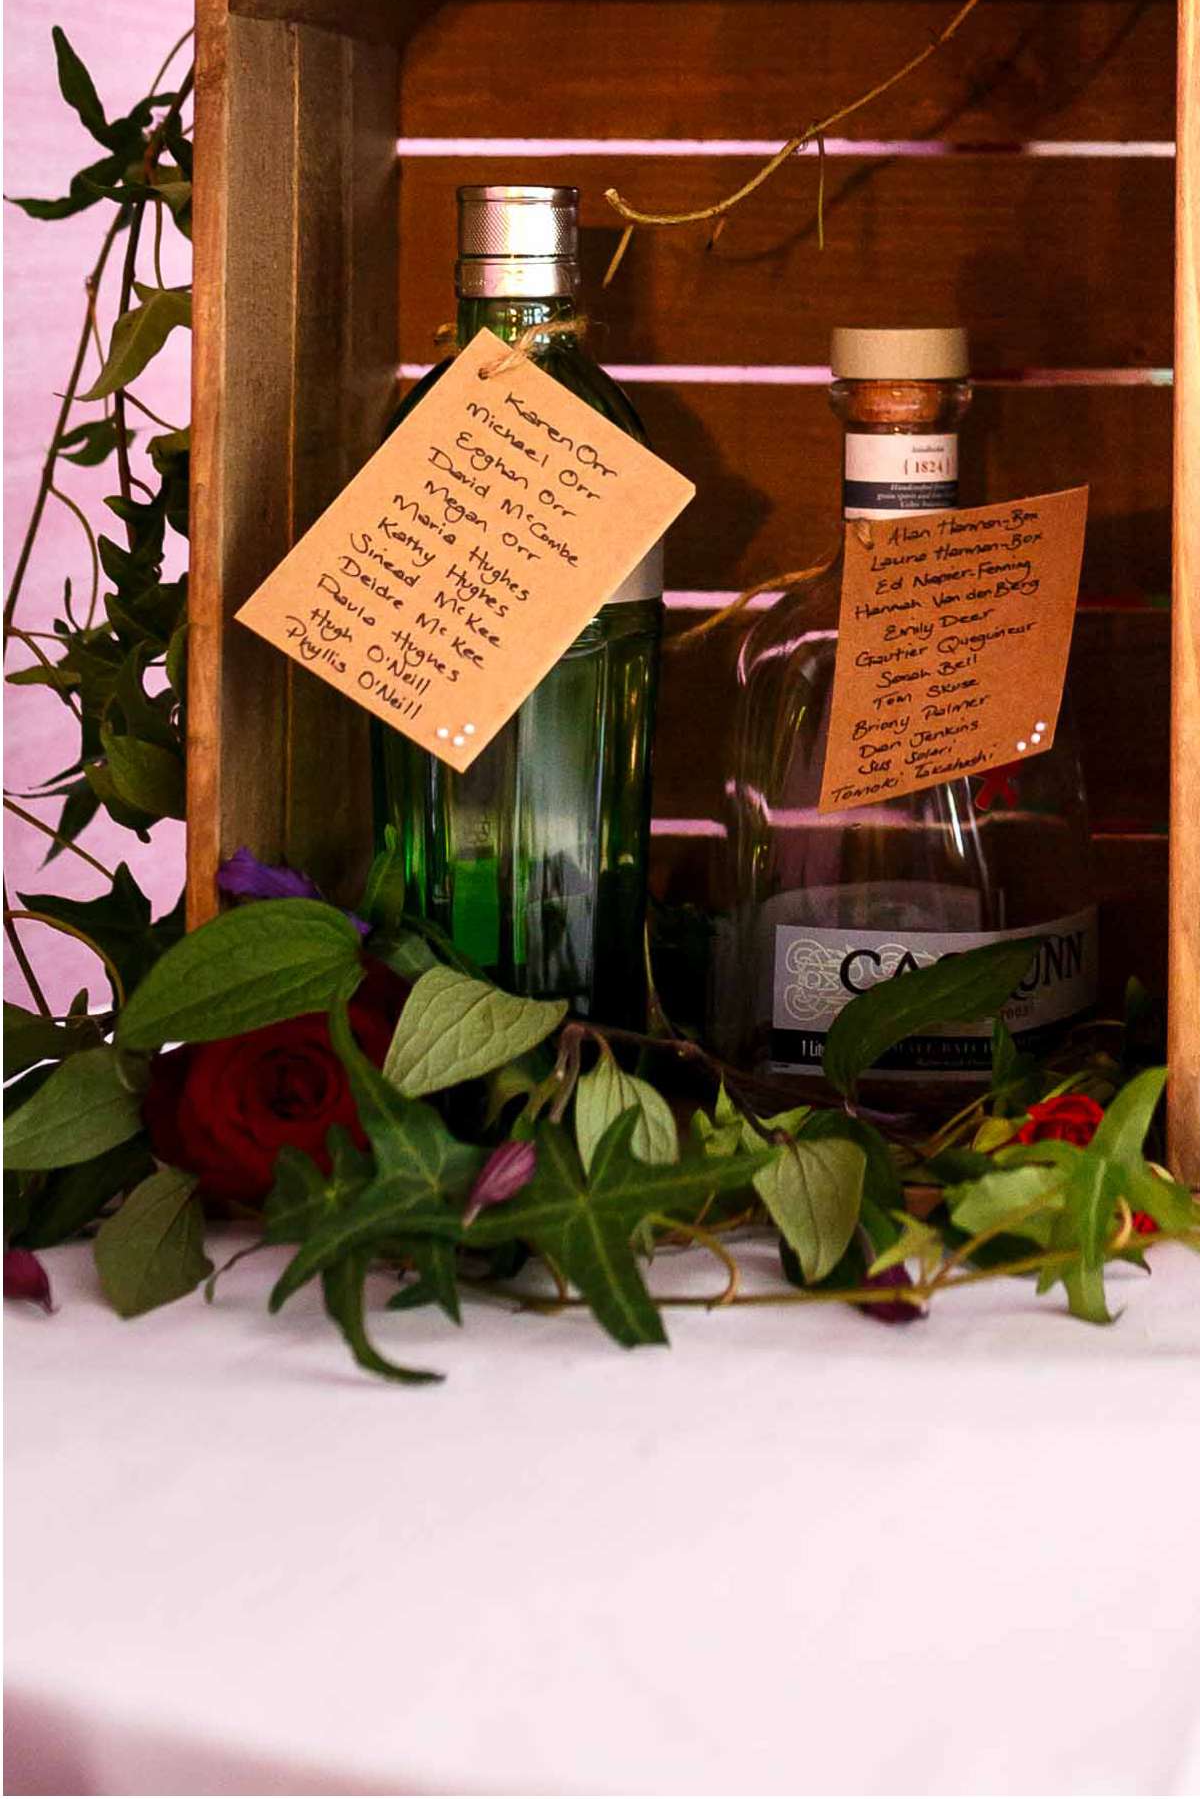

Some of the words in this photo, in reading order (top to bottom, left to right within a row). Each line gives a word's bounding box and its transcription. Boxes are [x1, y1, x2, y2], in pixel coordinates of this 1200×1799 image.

[466, 402, 549, 467] Michael
[558, 469, 600, 499] Orr
[504, 392, 573, 451] Karen
[576, 444, 617, 476] Orr
[913, 459, 943, 475] 1824
[424, 480, 487, 532] Megan
[502, 532, 541, 560] Orr
[428, 446, 490, 498] David
[500, 498, 578, 567] McCombe
[538, 489, 576, 516] Orr
[338, 555, 404, 609] Deidre
[350, 533, 421, 587] Sinead
[377, 516, 436, 567] Kathy
[445, 563, 509, 617] Hughes
[392, 495, 456, 545] Maria
[469, 546, 530, 601] Hughes
[285, 615, 346, 673] Phyllis
[357, 671, 422, 719] O'Neill
[310, 608, 352, 642] Hugh
[367, 644, 431, 695] O'Neill
[391, 630, 459, 682] Hughes
[876, 668, 931, 688] Sarah
